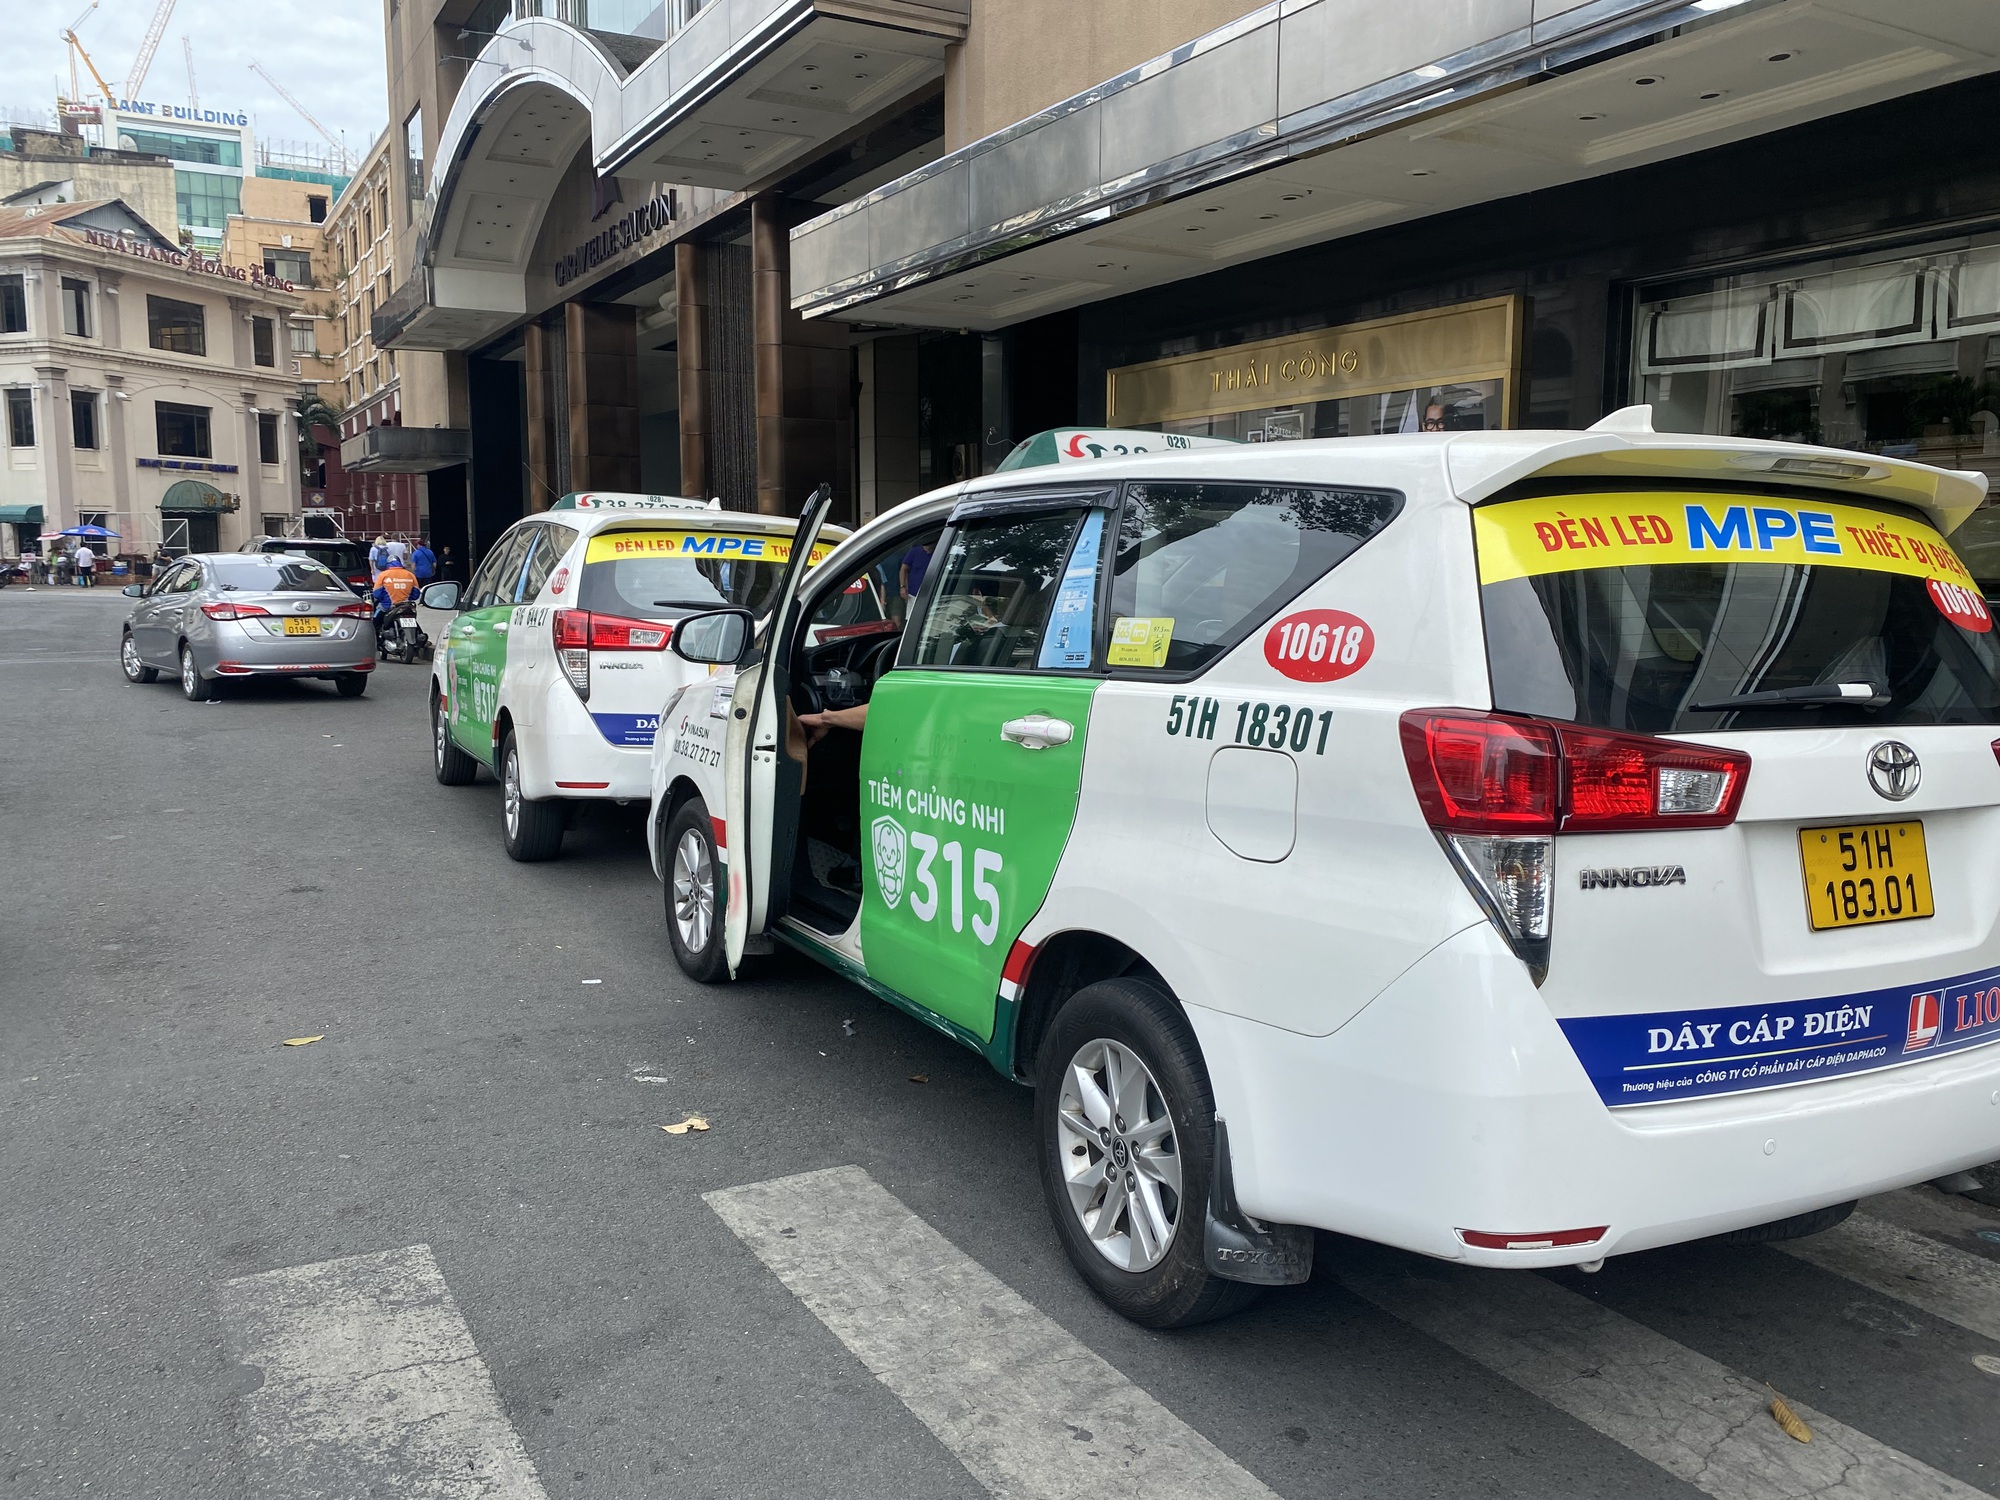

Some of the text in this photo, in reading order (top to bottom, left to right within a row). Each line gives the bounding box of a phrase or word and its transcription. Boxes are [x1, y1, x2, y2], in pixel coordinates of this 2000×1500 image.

[162, 104, 248, 127] BUILDING
[555, 224, 619, 287] CARAVELLE
[1209, 349, 1359, 393] THÁI CÔNG
[614, 537, 645, 553] ĐÈN
[648, 539, 675, 551] LED
[680, 536, 767, 556] MPE
[1534, 511, 1611, 552] ĐÈN
[1610, 514, 1675, 546] LED
[1683, 503, 1844, 556] MPE
[1845, 522, 1911, 561] THIẾT
[1905, 536, 1938, 573] BỊ
[293, 617, 310, 626] 51H
[1278, 622, 1364, 665] 10618
[599, 662, 644, 670] INNOVA
[687, 723, 710, 740] VINASUN
[1166, 694, 1334, 756] 51H 18301
[709, 750, 721, 768] 27
[868, 776, 1005, 836] TIÊM CHỦNG NHI
[1838, 828, 1894, 872] 51H
[910, 830, 1003, 946] 315
[1580, 864, 1687, 891] INNOVA
[1825, 873, 1918, 921] 183.01
[1648, 1004, 1874, 1053] DÂY CÁP ĐIỆN
[1622, 1046, 1887, 1093] Thương hiệu của CÔNG TY CỔ PHẦN DÂY CÁP ĐIỆN DAPHACO
[1217, 1247, 1300, 1266] TOYOTA
